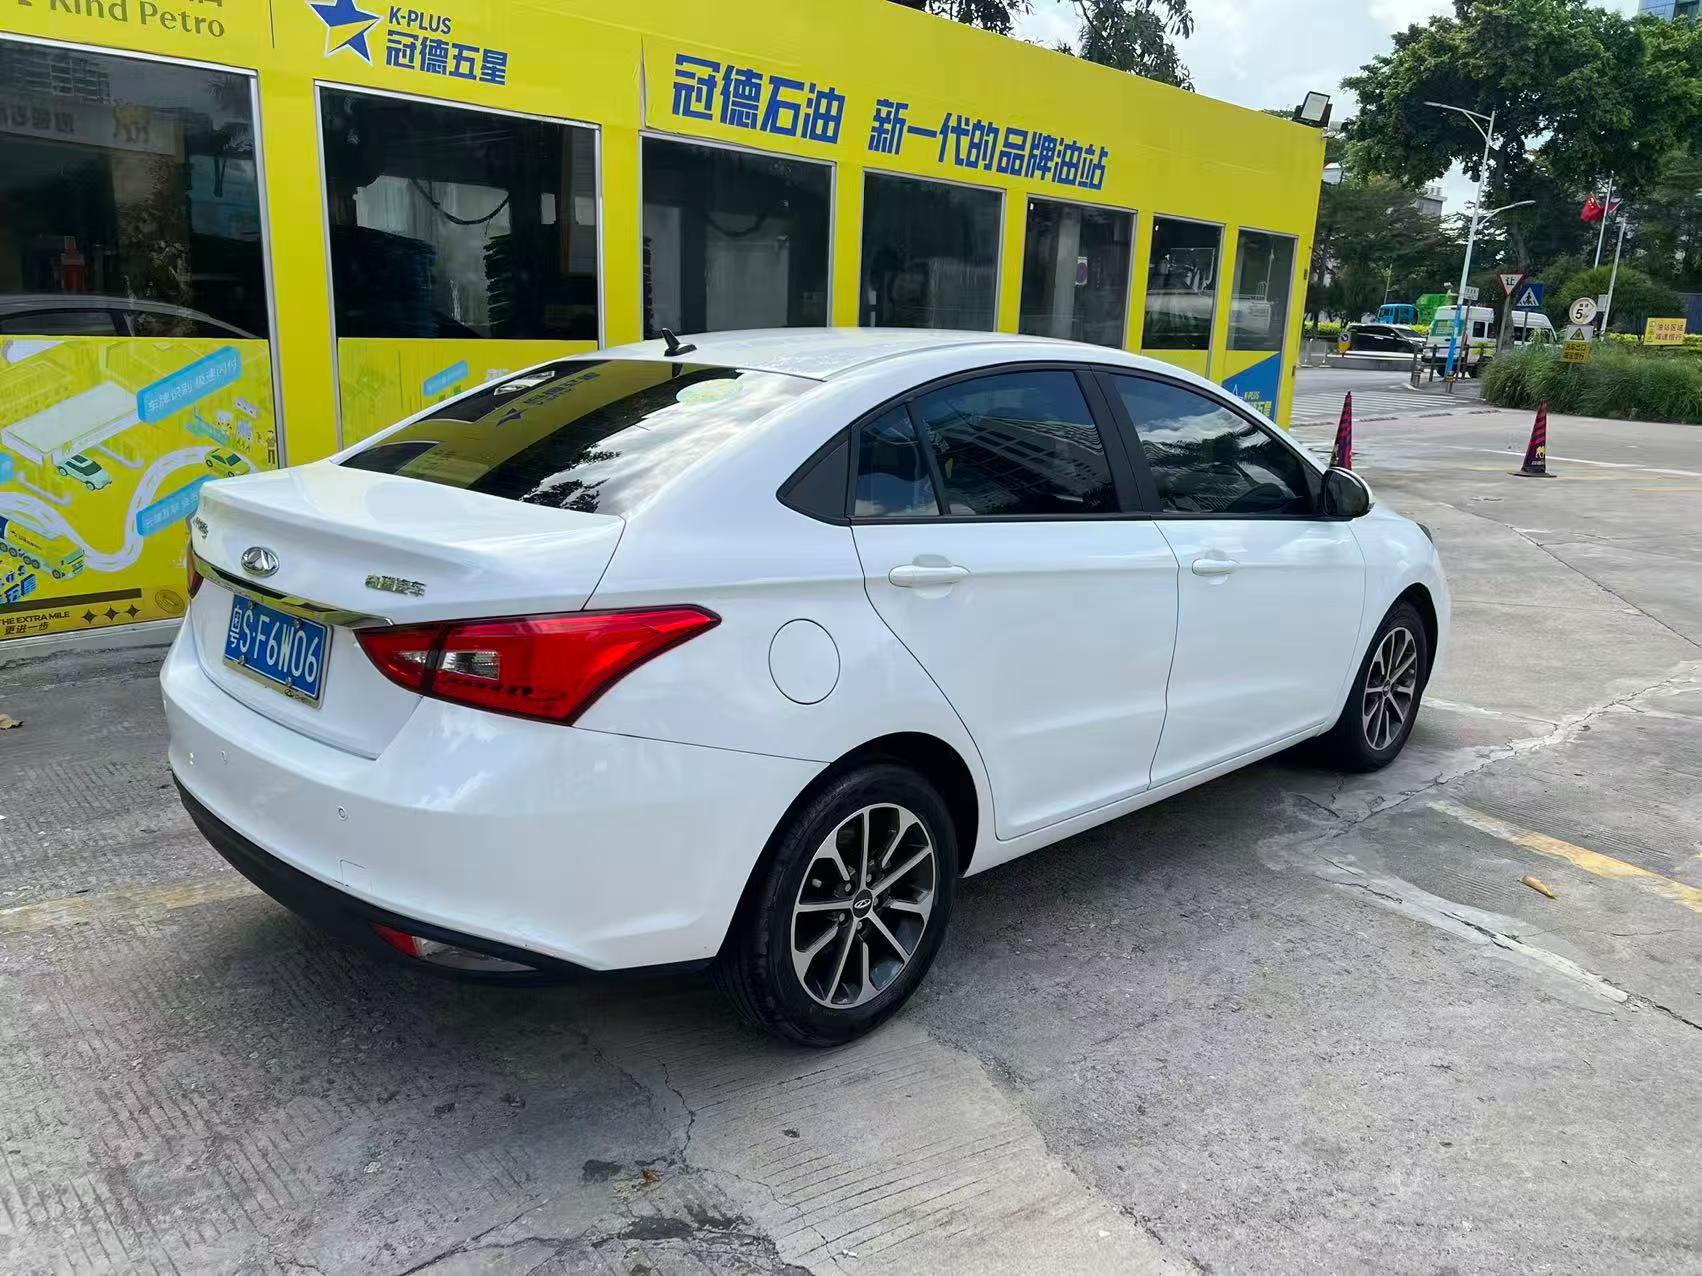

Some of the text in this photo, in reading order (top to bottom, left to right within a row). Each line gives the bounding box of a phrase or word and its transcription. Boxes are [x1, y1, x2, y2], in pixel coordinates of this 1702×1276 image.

[140, 1, 225, 37] Petro
[388, 6, 452, 36] K-PLUS
[386, 29, 508, 86] 冠德五星
[672, 53, 1109, 190] 冠德石油 新一代的品牌油站
[1505, 276, 1515, 286] 让
[1575, 308, 1583, 319] 5
[16, 614, 48, 624] EXTRA
[49, 611, 70, 619] MILE
[4, 622, 49, 635] 更进一步
